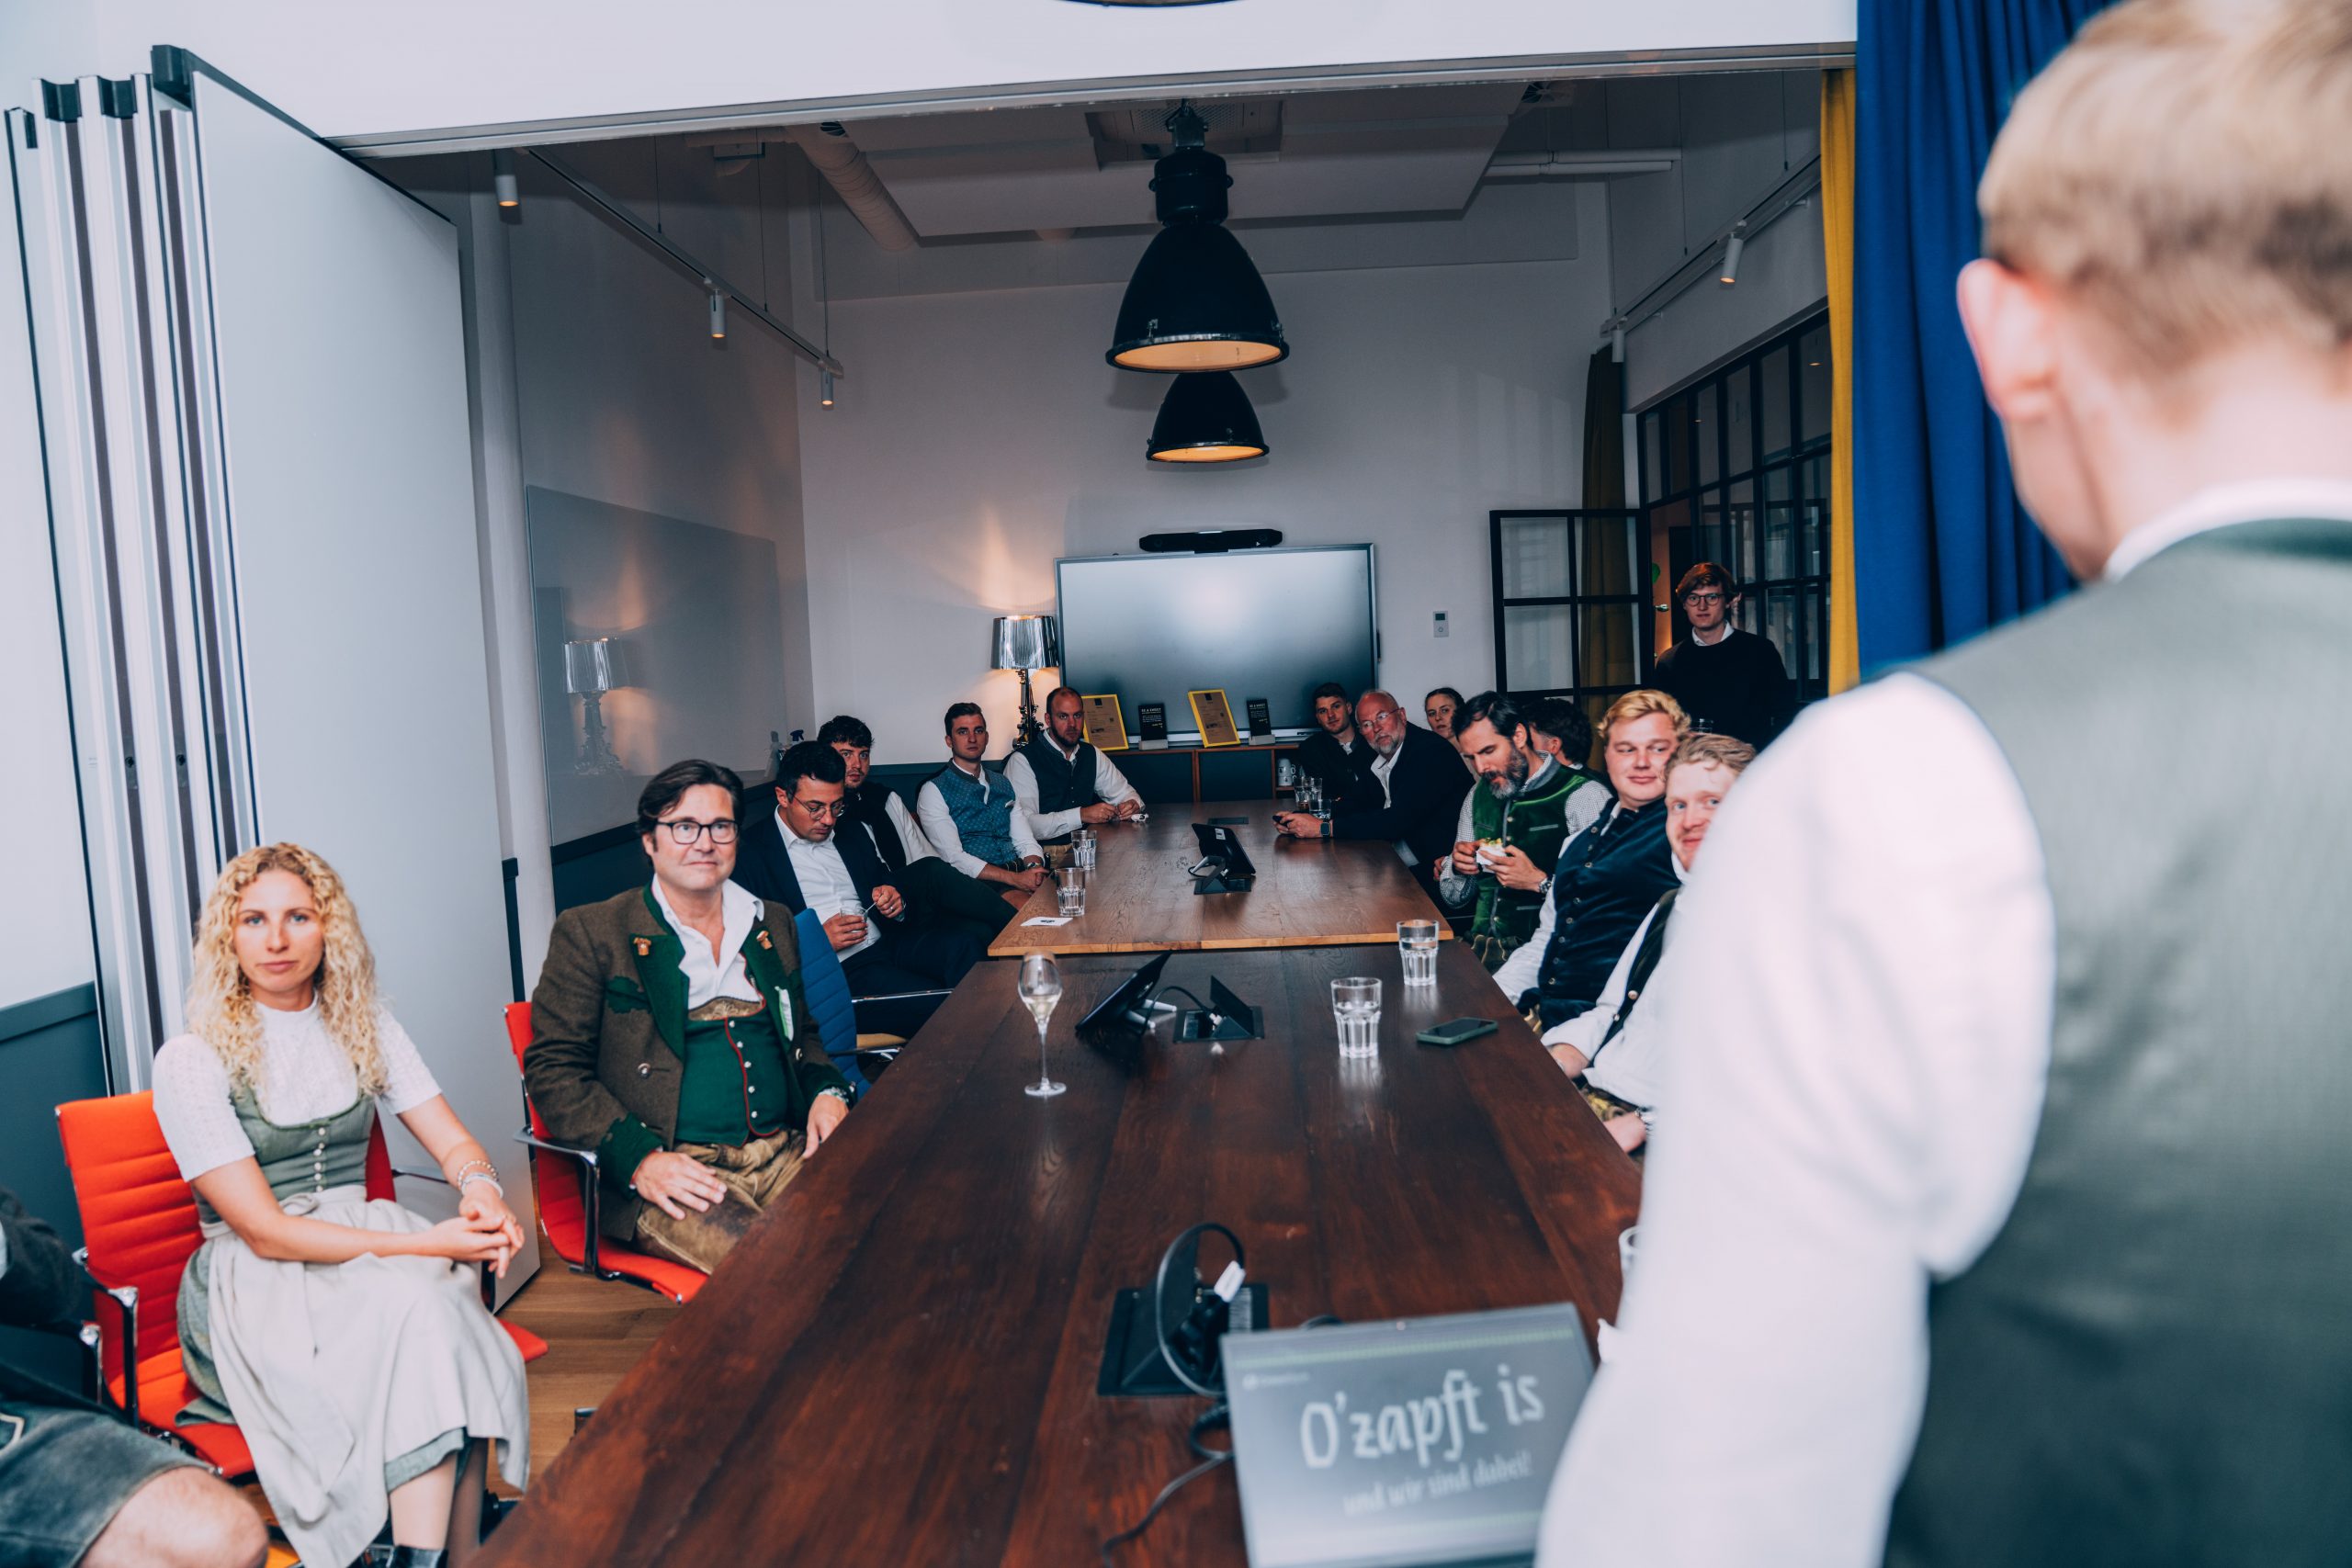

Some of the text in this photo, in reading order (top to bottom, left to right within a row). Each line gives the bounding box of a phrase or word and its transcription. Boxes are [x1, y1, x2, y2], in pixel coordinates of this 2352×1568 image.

[1300, 1363, 1545, 1468] O'zapft is
[1344, 1483, 1384, 1516] und
[1387, 1476, 1424, 1507] wir
[1427, 1462, 1471, 1499] sind
